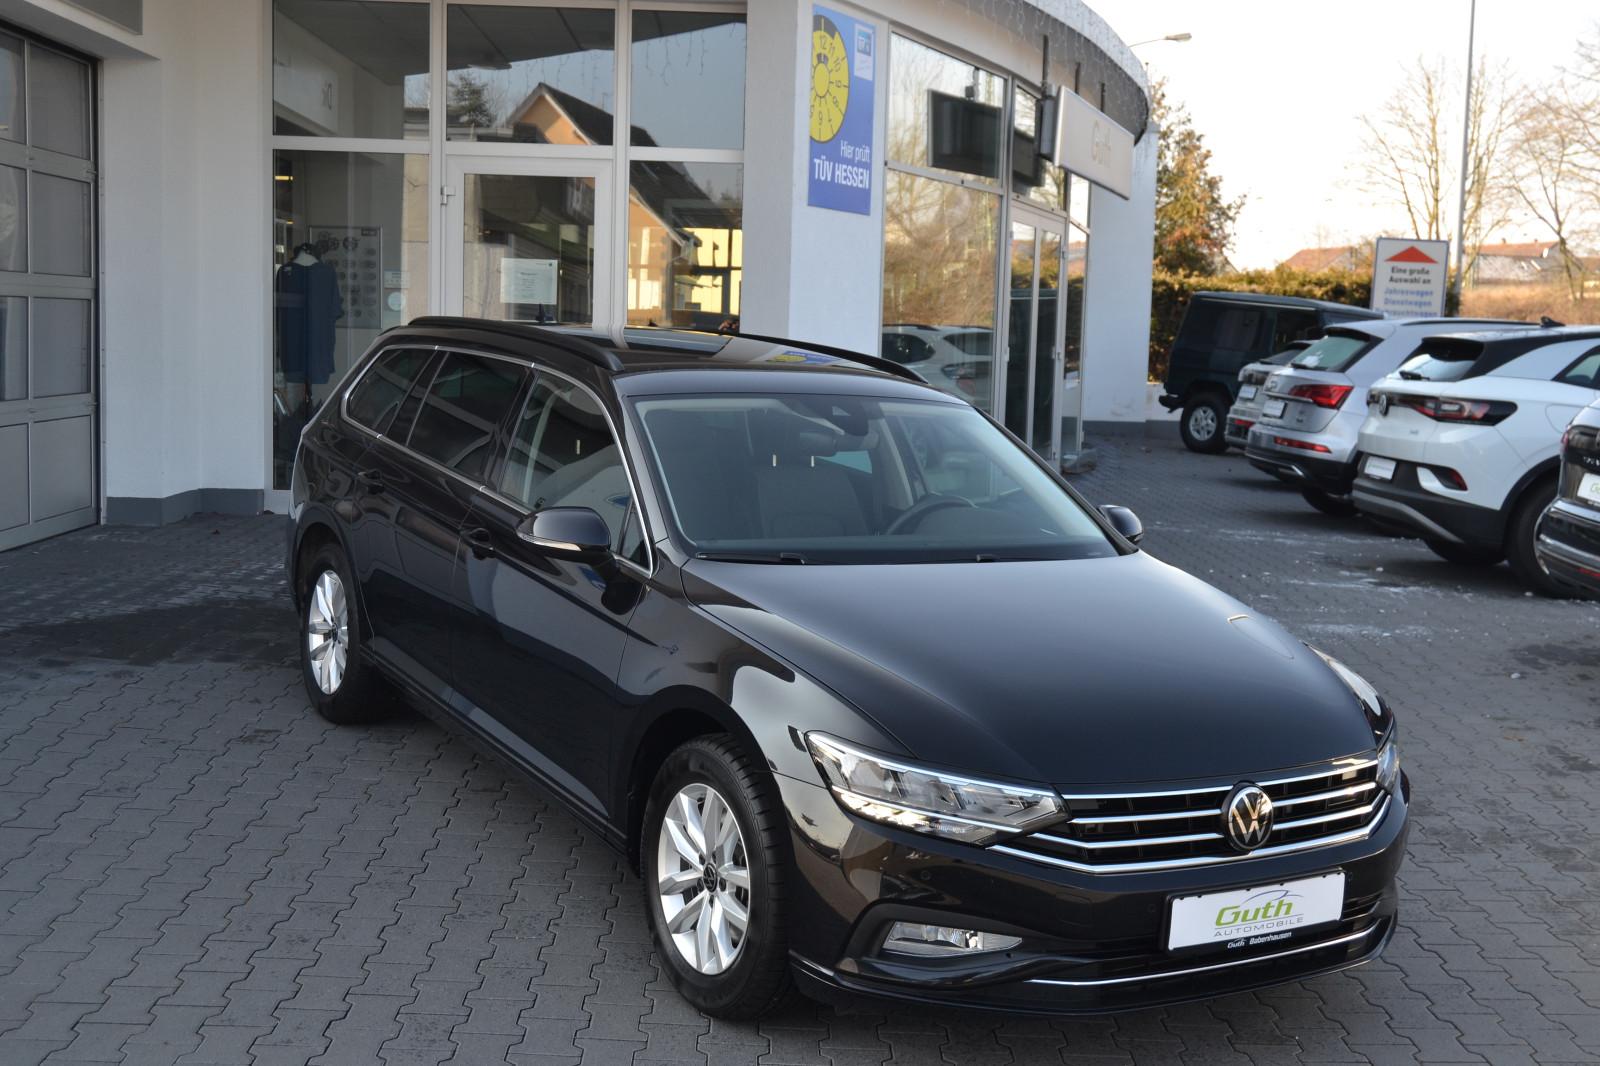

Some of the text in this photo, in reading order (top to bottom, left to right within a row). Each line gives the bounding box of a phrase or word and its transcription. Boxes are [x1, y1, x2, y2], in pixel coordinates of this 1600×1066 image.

[840, 139, 870, 164] Hier prüft
[813, 154, 870, 190] TÜV HESSEN
[1388, 275, 1421, 284] Auswahl
[1391, 265, 1430, 276] Eine große
[1215, 899, 1293, 927] Guth
[1214, 916, 1304, 937] AUTOMOBILE
[1227, 931, 1292, 949] Guth Babenhausen
